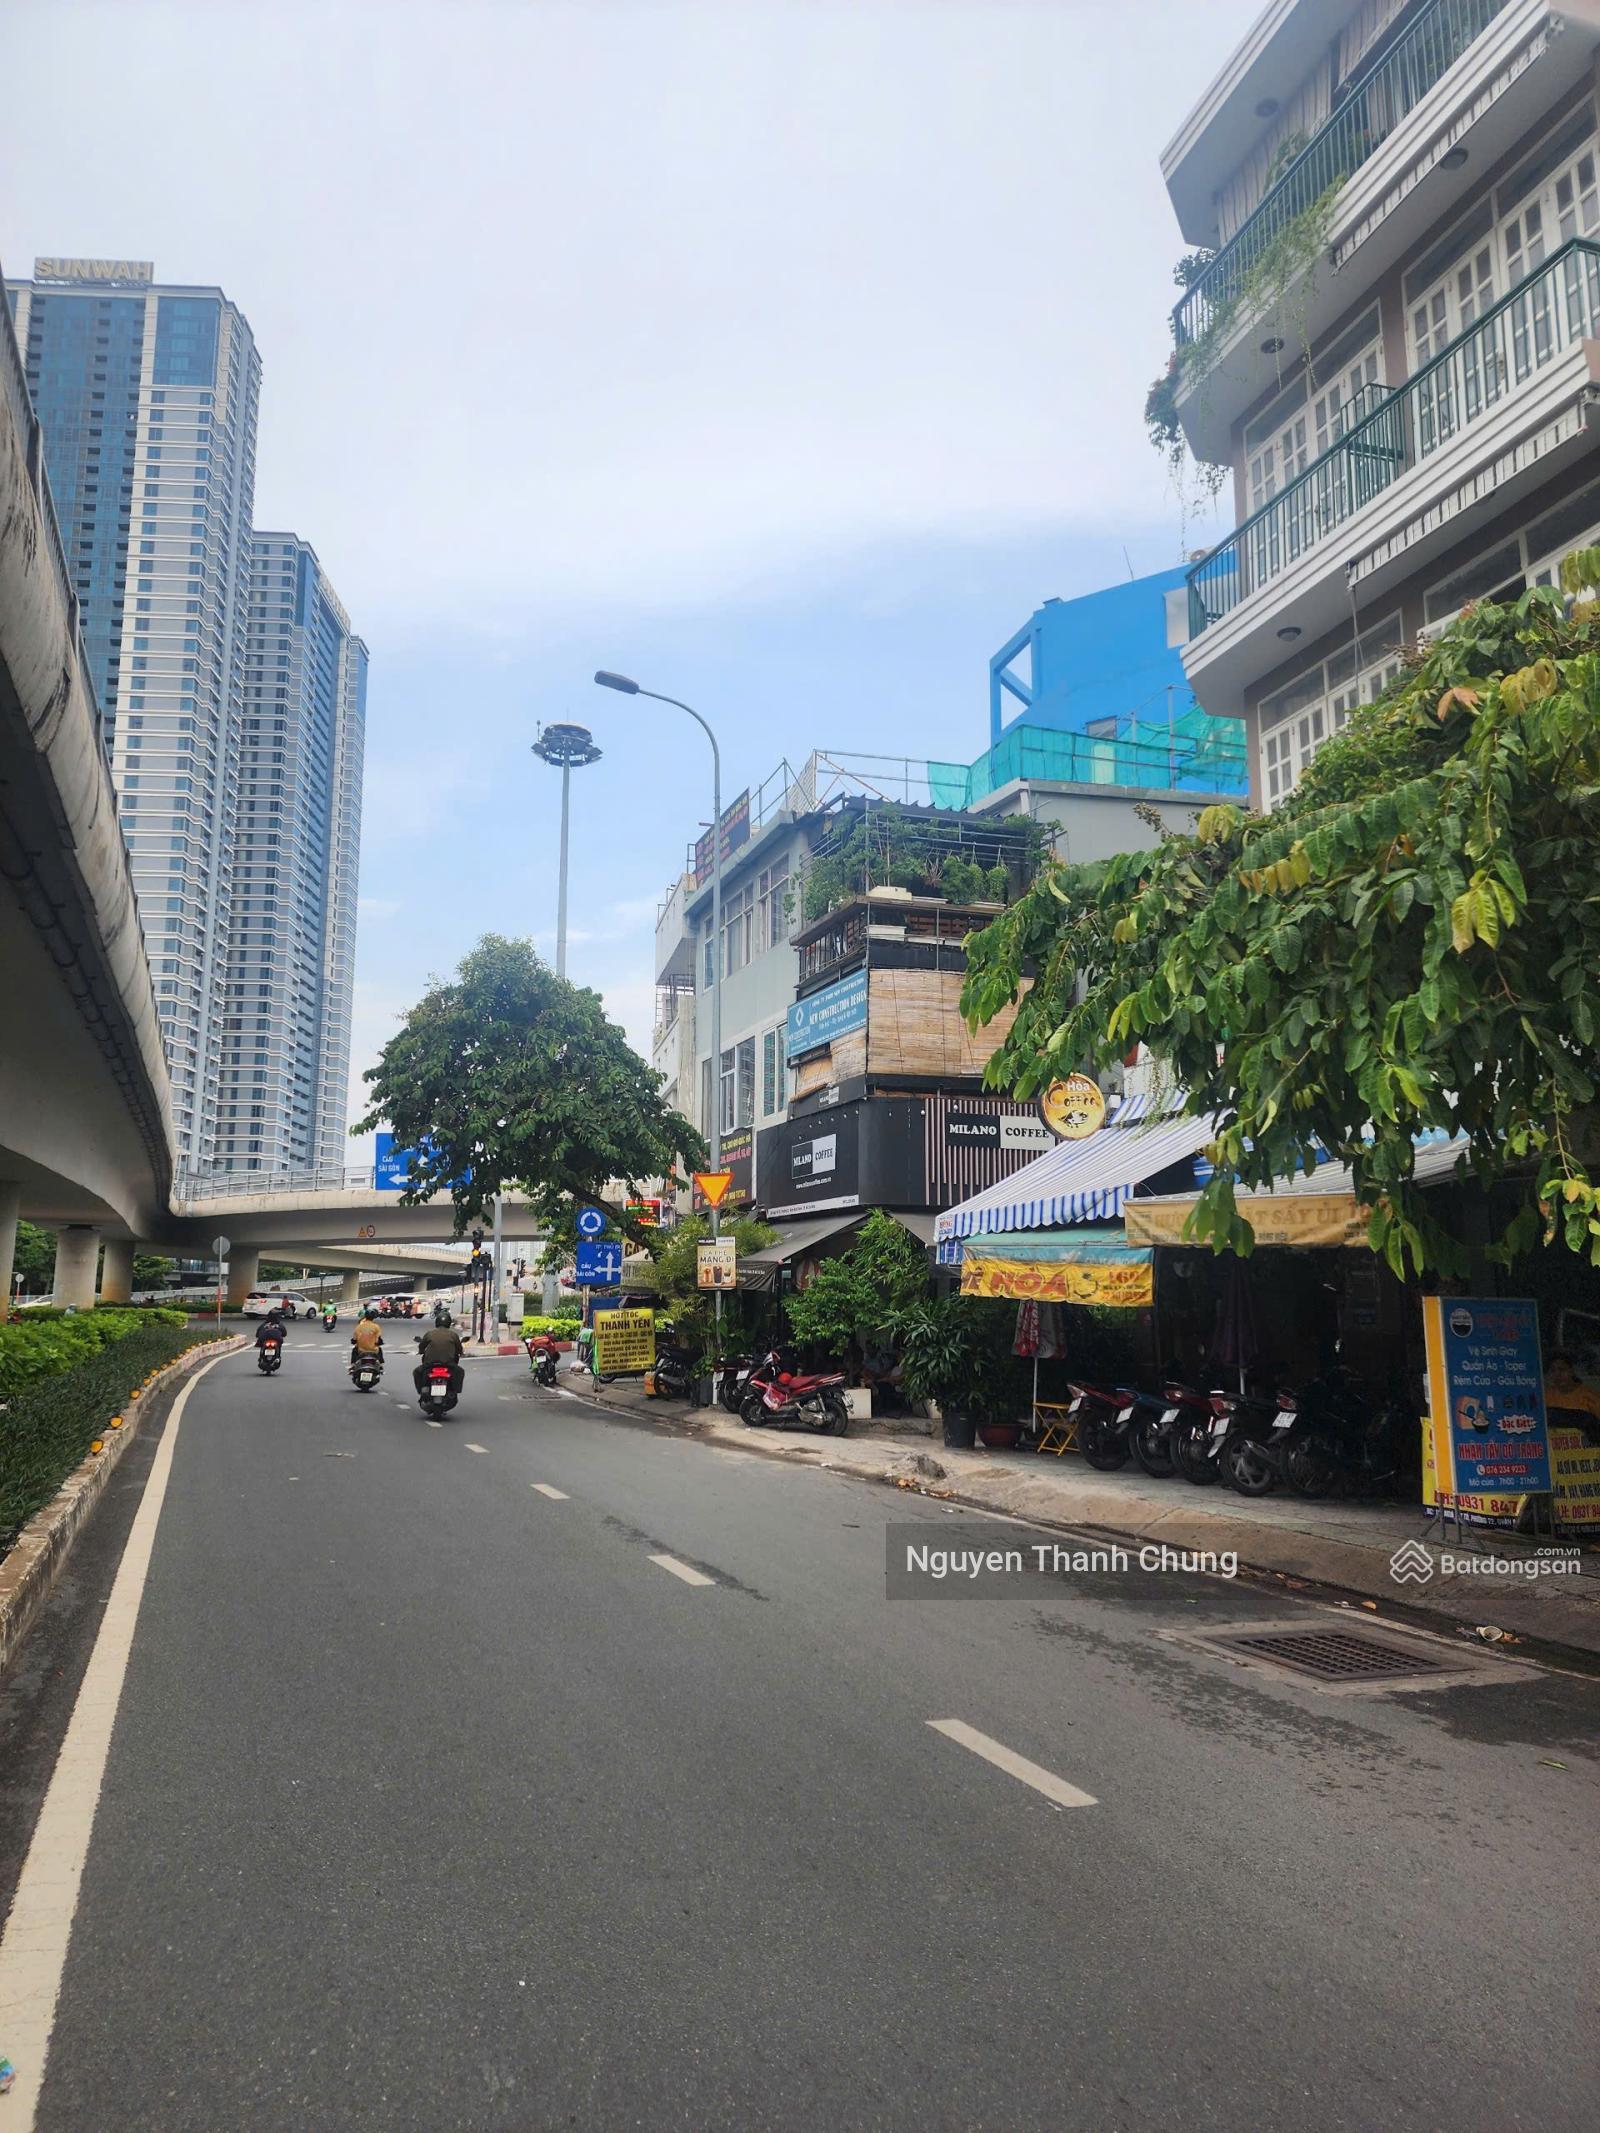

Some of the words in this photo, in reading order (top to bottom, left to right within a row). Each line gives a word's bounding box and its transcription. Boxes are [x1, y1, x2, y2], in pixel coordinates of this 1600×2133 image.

[35, 257, 152, 280] SUNWAH
[818, 999, 850, 1020] CONSTRUCTION
[851, 990, 867, 1006] DESIGN
[1067, 1080, 1091, 1092] Hòa
[949, 1123, 998, 1136] MILANO
[1005, 1127, 1050, 1139] COFFEE
[793, 1153, 812, 1167] MILANO
[815, 1148, 833, 1160] COFFEE
[1271, 1201, 1311, 1225] SẤY
[600, 1319, 630, 1330] THANH
[1481, 1346, 1498, 1356] Sinh
[1458, 1440, 1482, 1460] NHẬN
[1499, 1465, 1510, 1474] 234
[1456, 1494, 1485, 1511] 0931
[1490, 1499, 1518, 1513] 847
